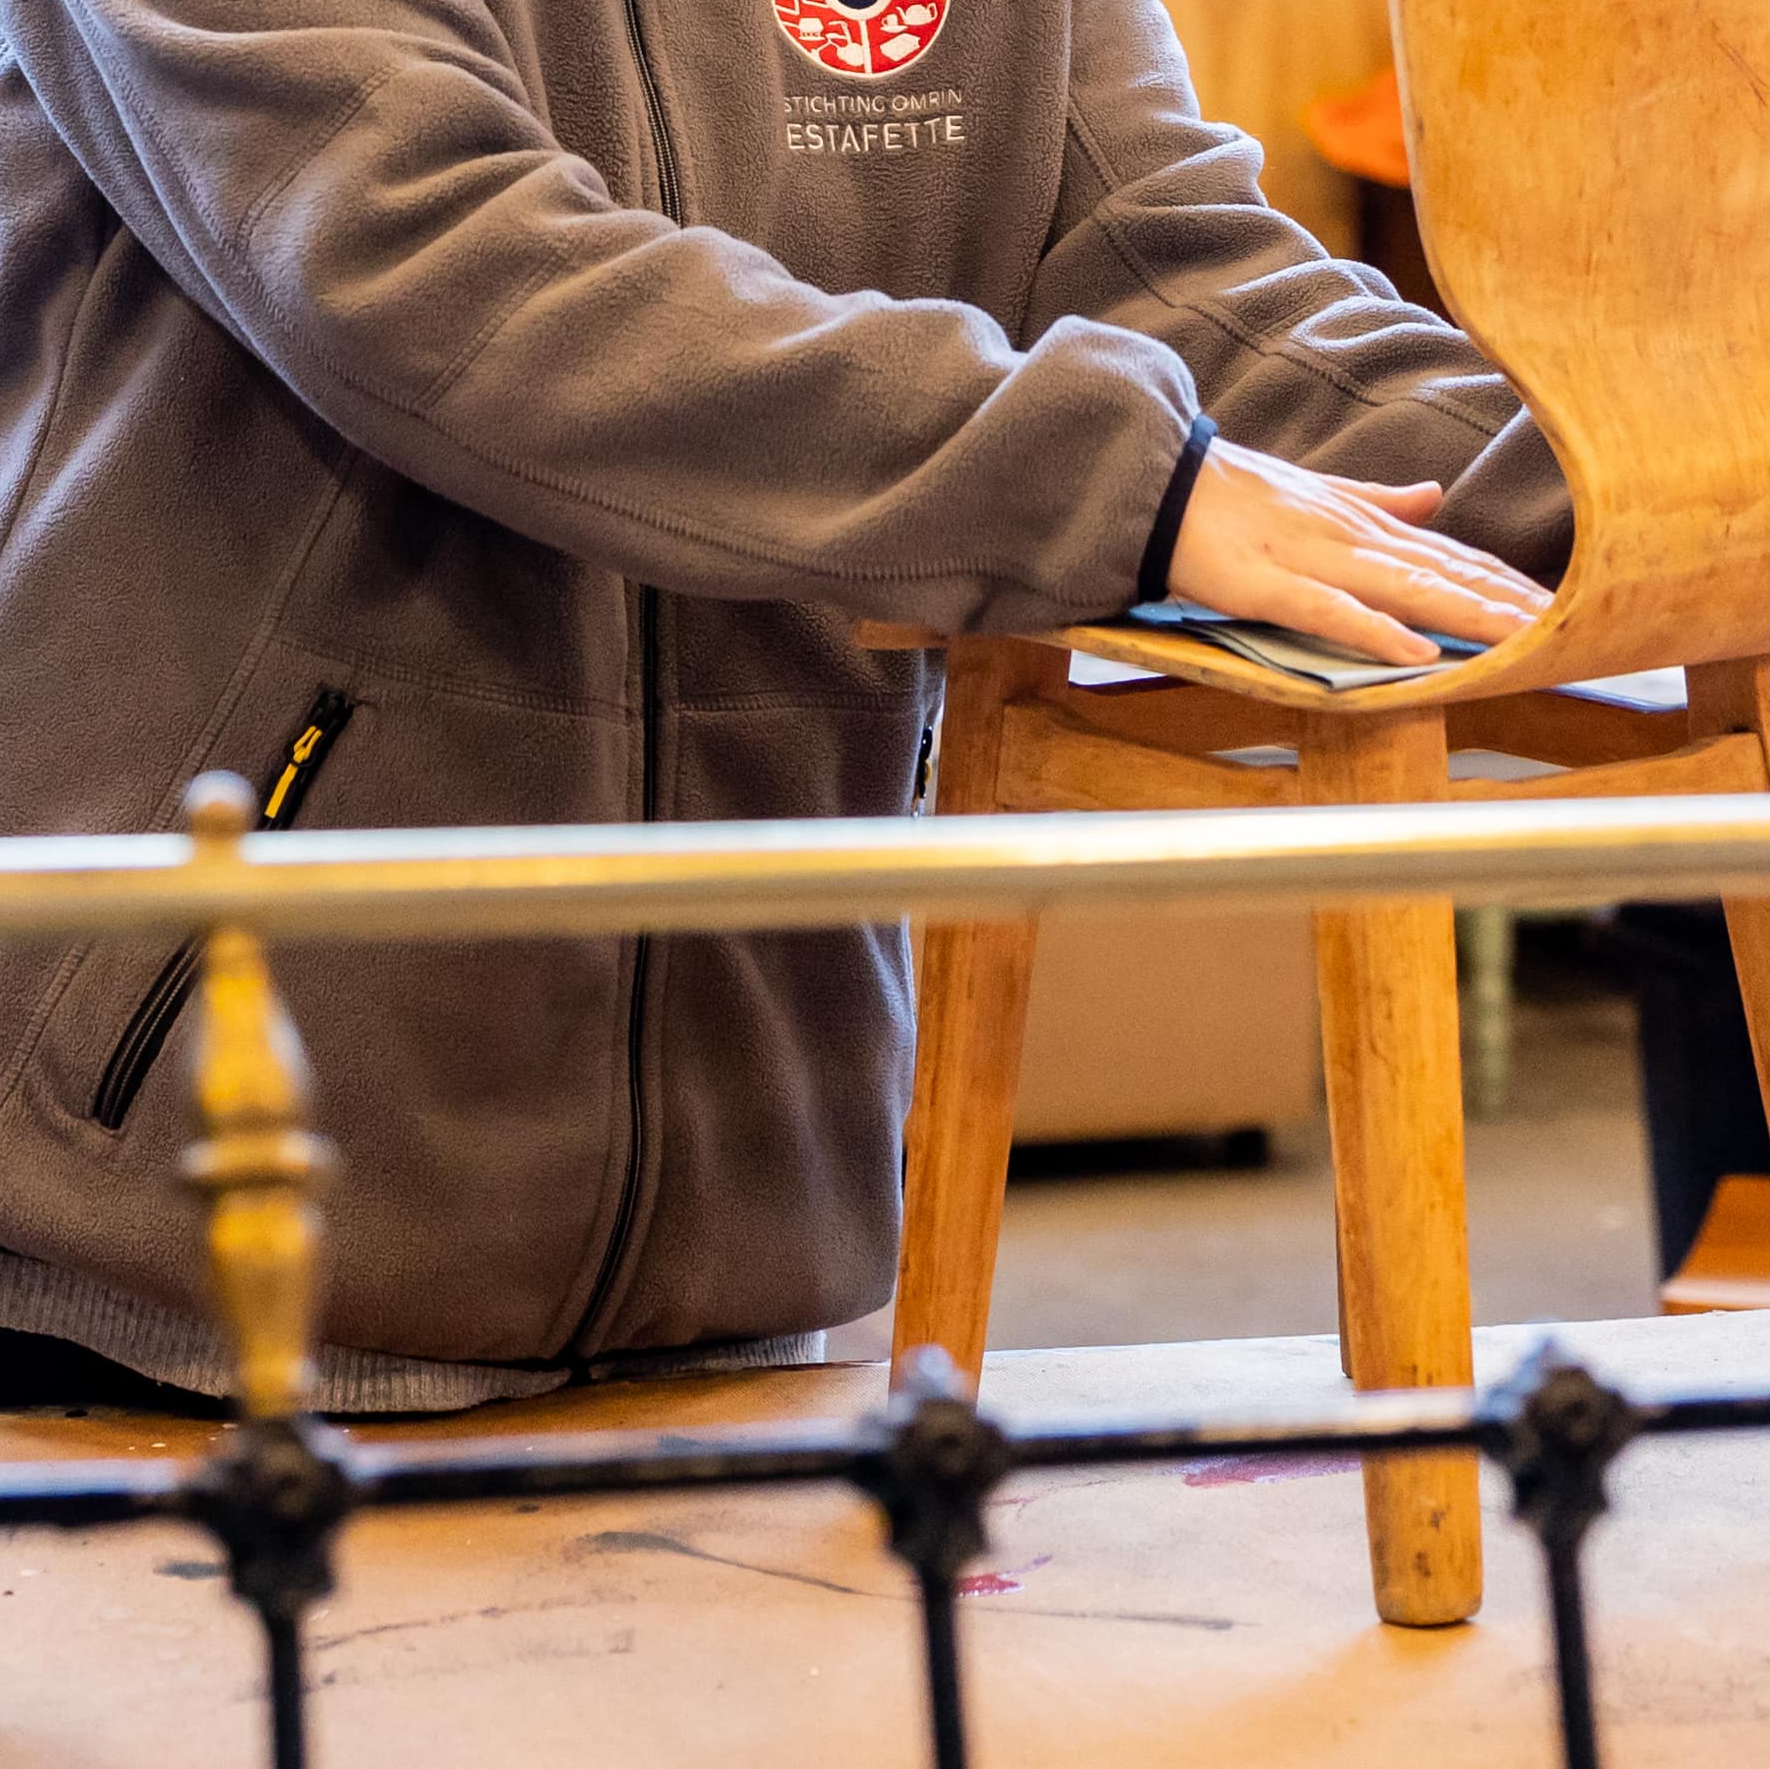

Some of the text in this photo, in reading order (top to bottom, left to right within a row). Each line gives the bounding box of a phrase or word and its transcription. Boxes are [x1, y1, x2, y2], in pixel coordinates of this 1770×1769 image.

[783, 88, 963, 114] STICHTING OMRIN
[786, 115, 966, 152] ESTAFETTE
